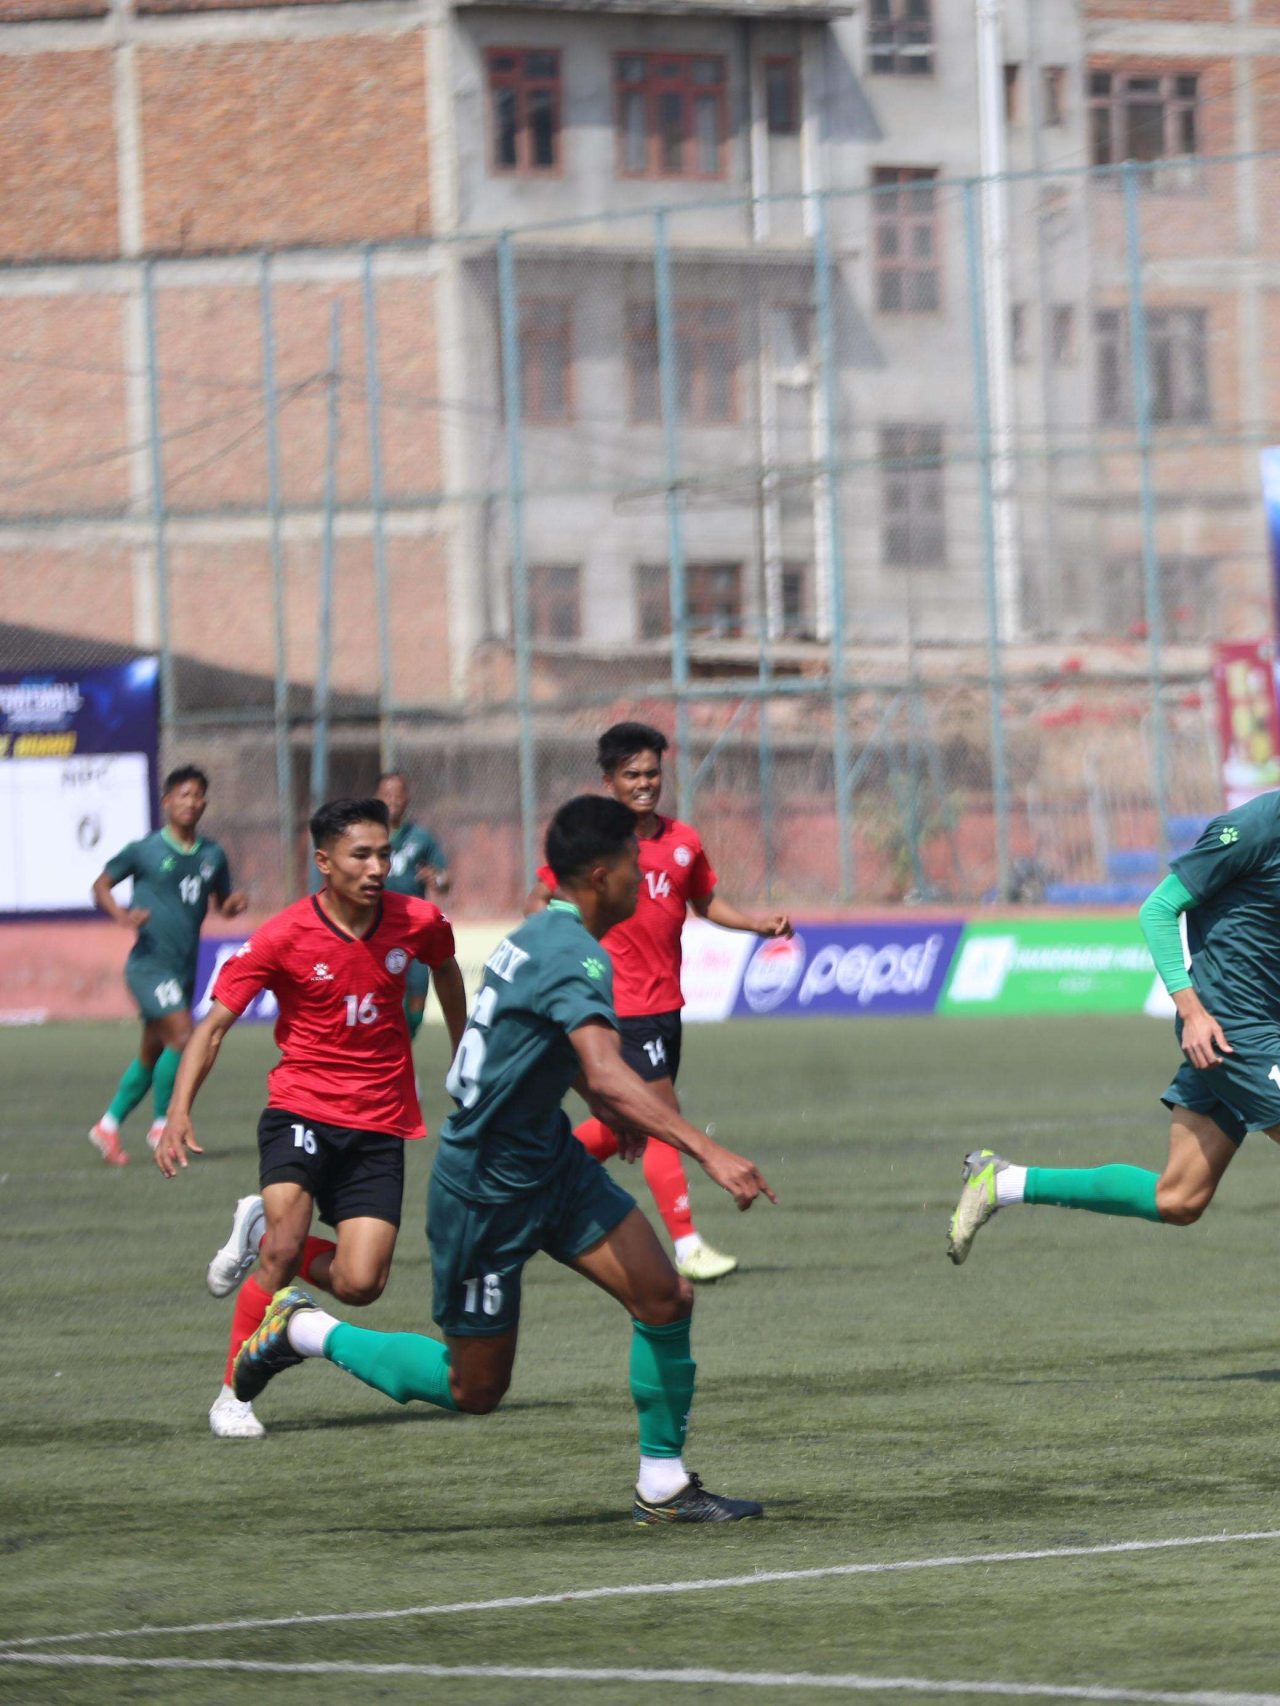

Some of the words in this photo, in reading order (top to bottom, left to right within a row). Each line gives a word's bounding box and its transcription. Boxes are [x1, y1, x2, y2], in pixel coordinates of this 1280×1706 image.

[645, 871, 670, 899] 14
[798, 932, 944, 1007] pepsi
[344, 992, 378, 1027] 16
[643, 1037, 666, 1065] 14
[290, 1123, 317, 1156] 16
[462, 1273, 503, 1316] 16
